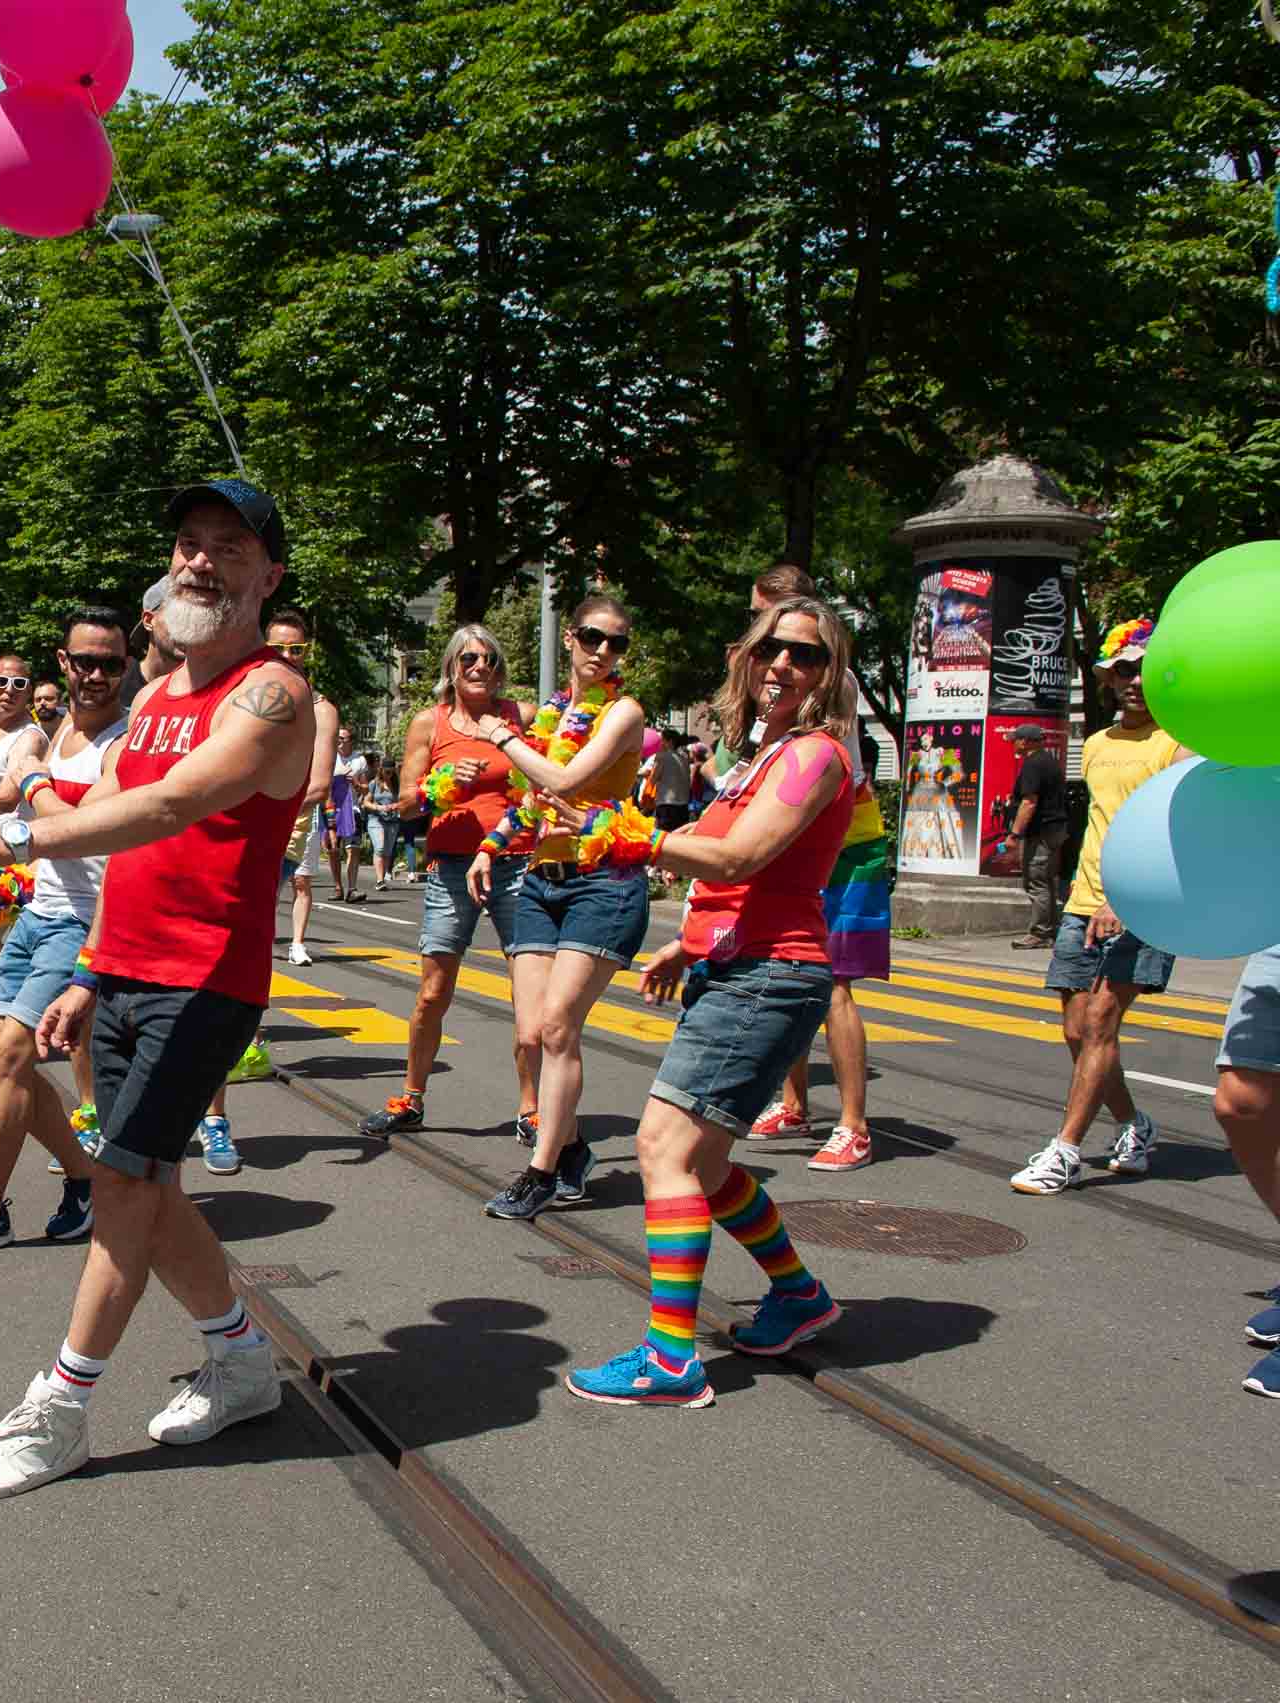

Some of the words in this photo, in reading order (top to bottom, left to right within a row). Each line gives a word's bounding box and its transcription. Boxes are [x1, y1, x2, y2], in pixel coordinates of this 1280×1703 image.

[1032, 655, 1070, 671] BRUCE
[936, 687, 984, 698] Tattoo.
[128, 714, 199, 754] OACH
